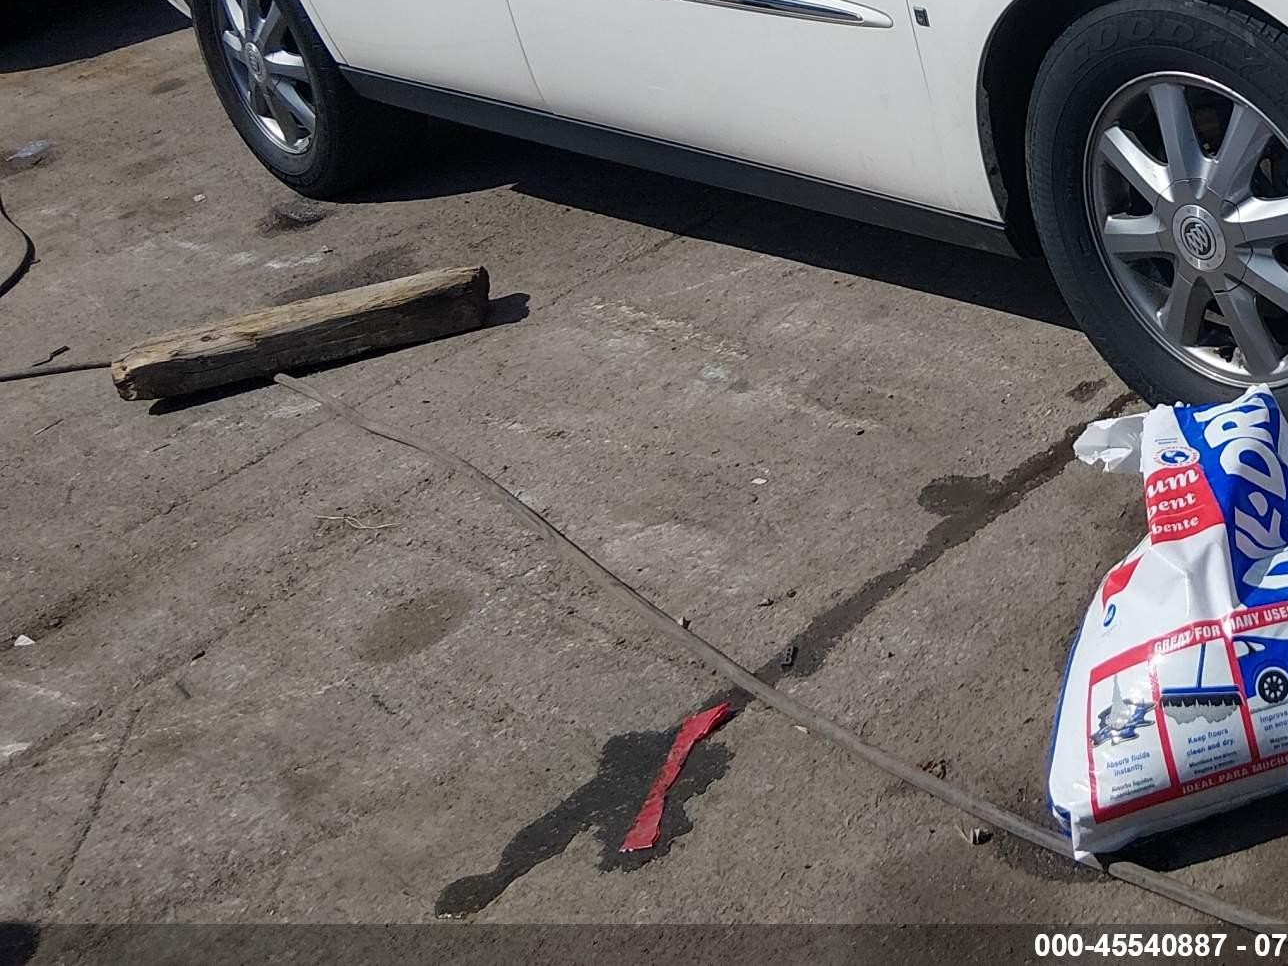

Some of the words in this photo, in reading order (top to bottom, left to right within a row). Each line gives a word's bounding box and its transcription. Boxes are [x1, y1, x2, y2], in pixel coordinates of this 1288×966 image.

[1154, 630, 1191, 655] GREAT
[1194, 625, 1220, 640] FOR
[1260, 710, 1288, 723] Improve
[1188, 734, 1207, 744] Keep
[1207, 728, 1229, 739] floors
[1264, 724, 1274, 732] on
[1187, 747, 1206, 756] clean
[1207, 741, 1221, 751] and
[1106, 757, 1130, 769] Absorb
[1131, 750, 1151, 762] fluids
[1183, 778, 1216, 794] IDEAL
[1219, 768, 1248, 783] PARA
